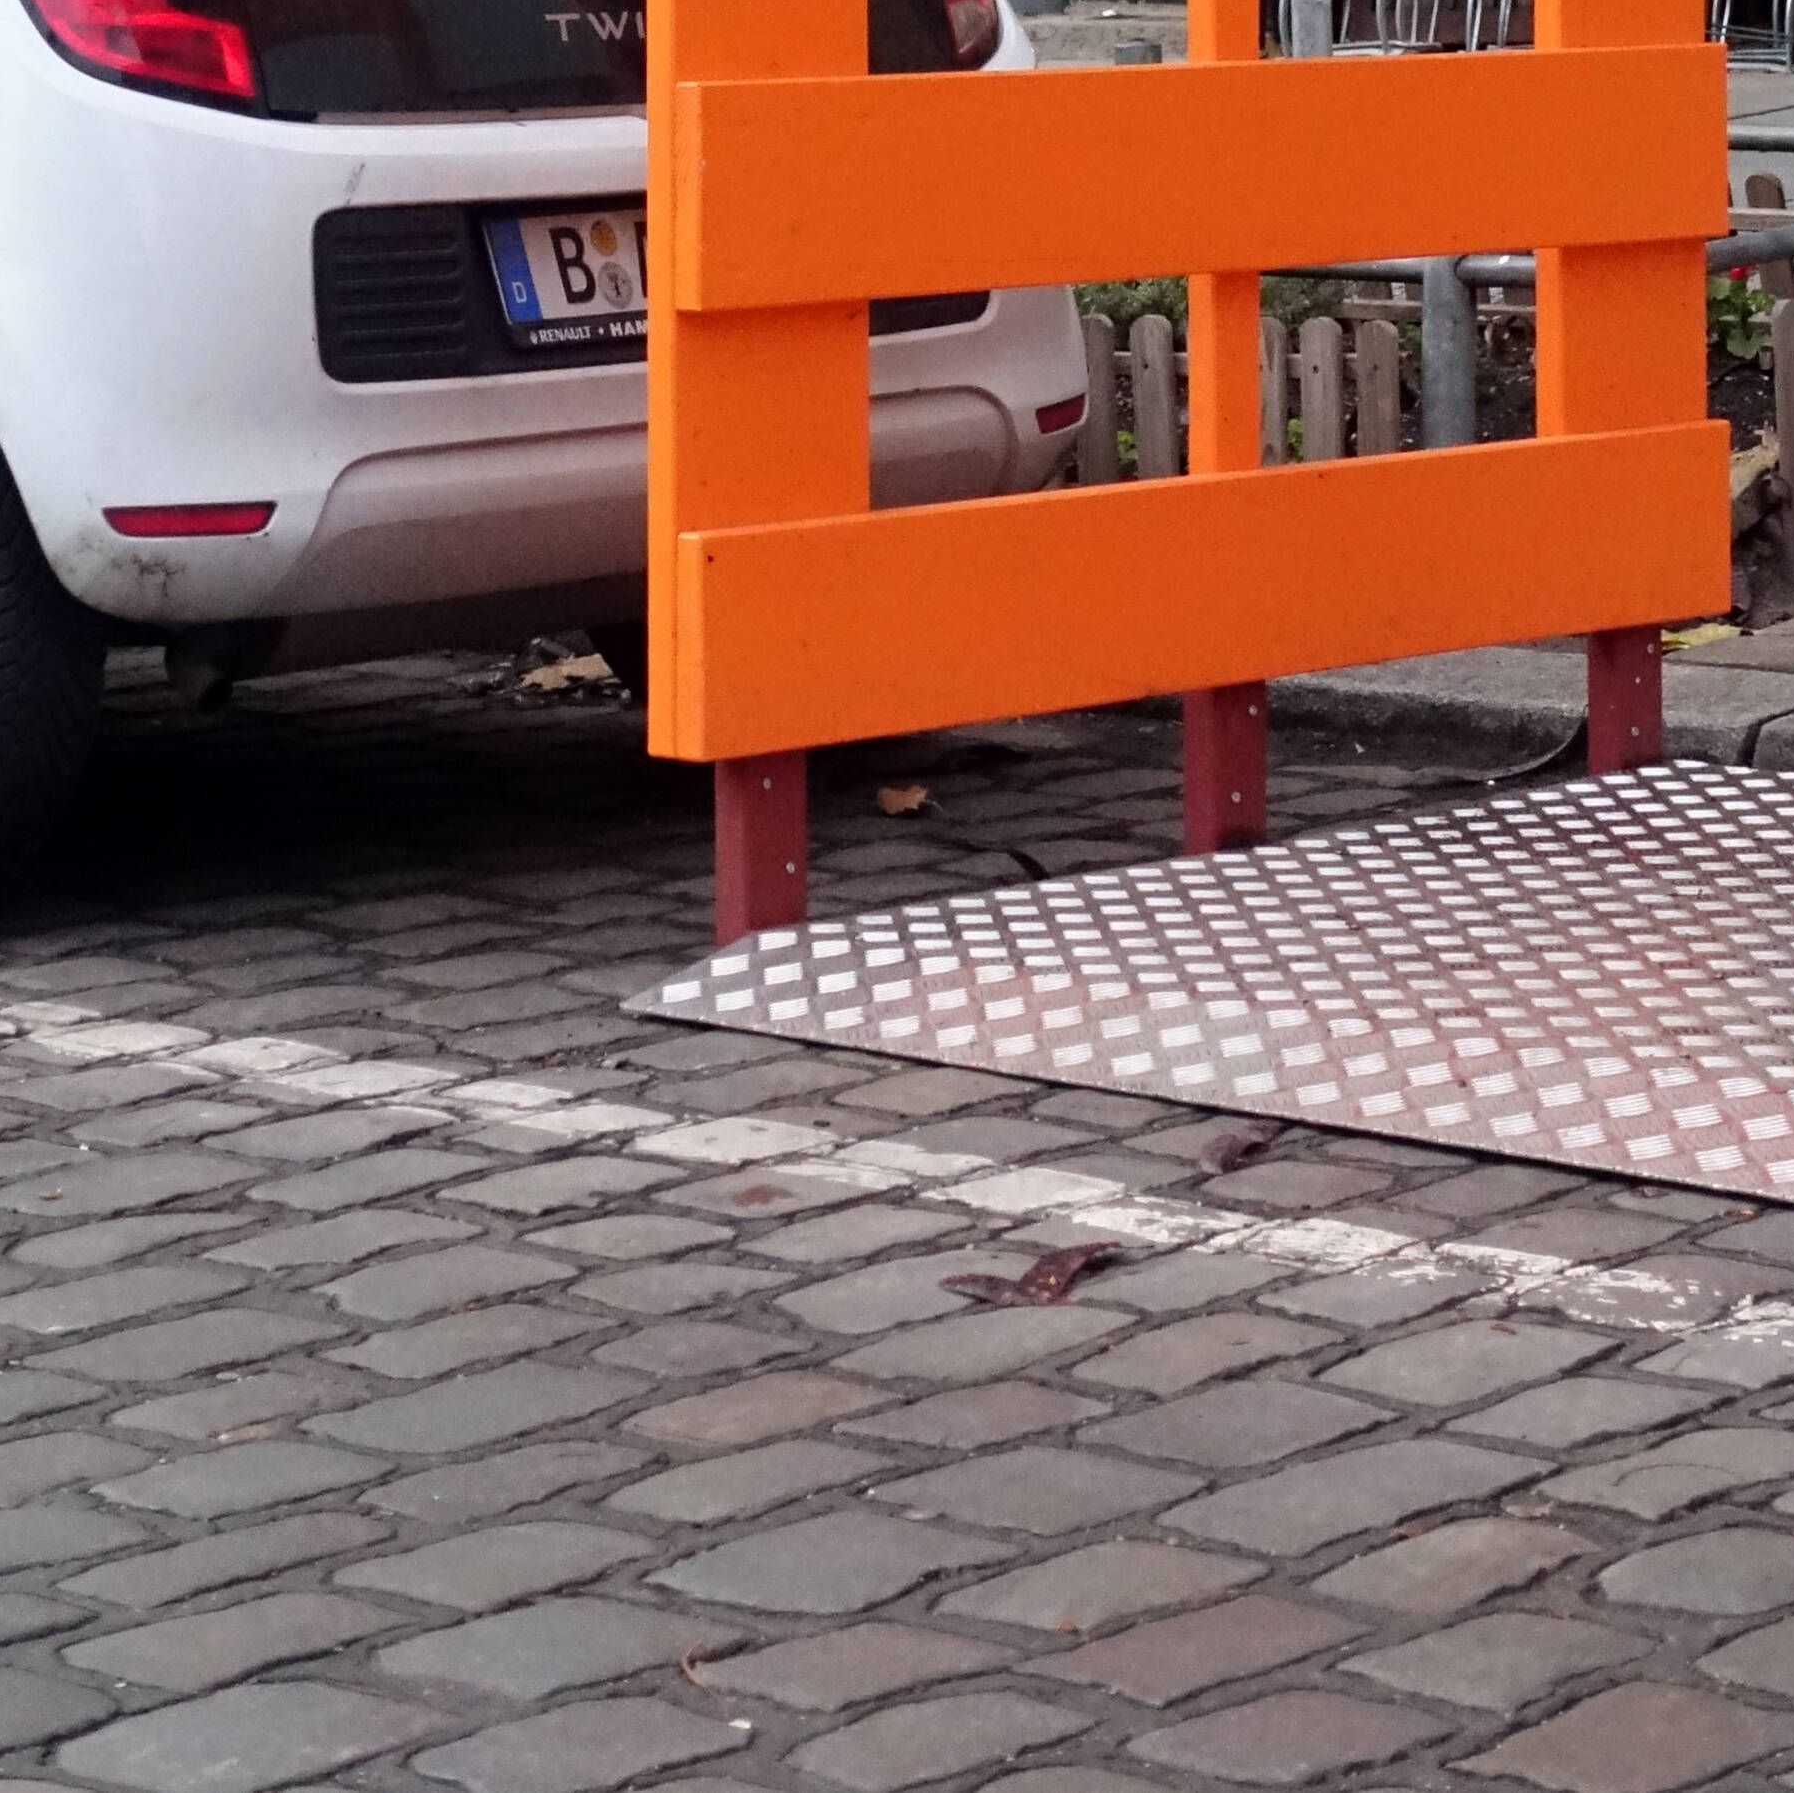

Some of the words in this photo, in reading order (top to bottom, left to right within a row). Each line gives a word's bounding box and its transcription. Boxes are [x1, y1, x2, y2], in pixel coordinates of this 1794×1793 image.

[544, 10, 647, 42] TWI
[548, 226, 596, 305] B
[538, 325, 591, 344] RENAULT
